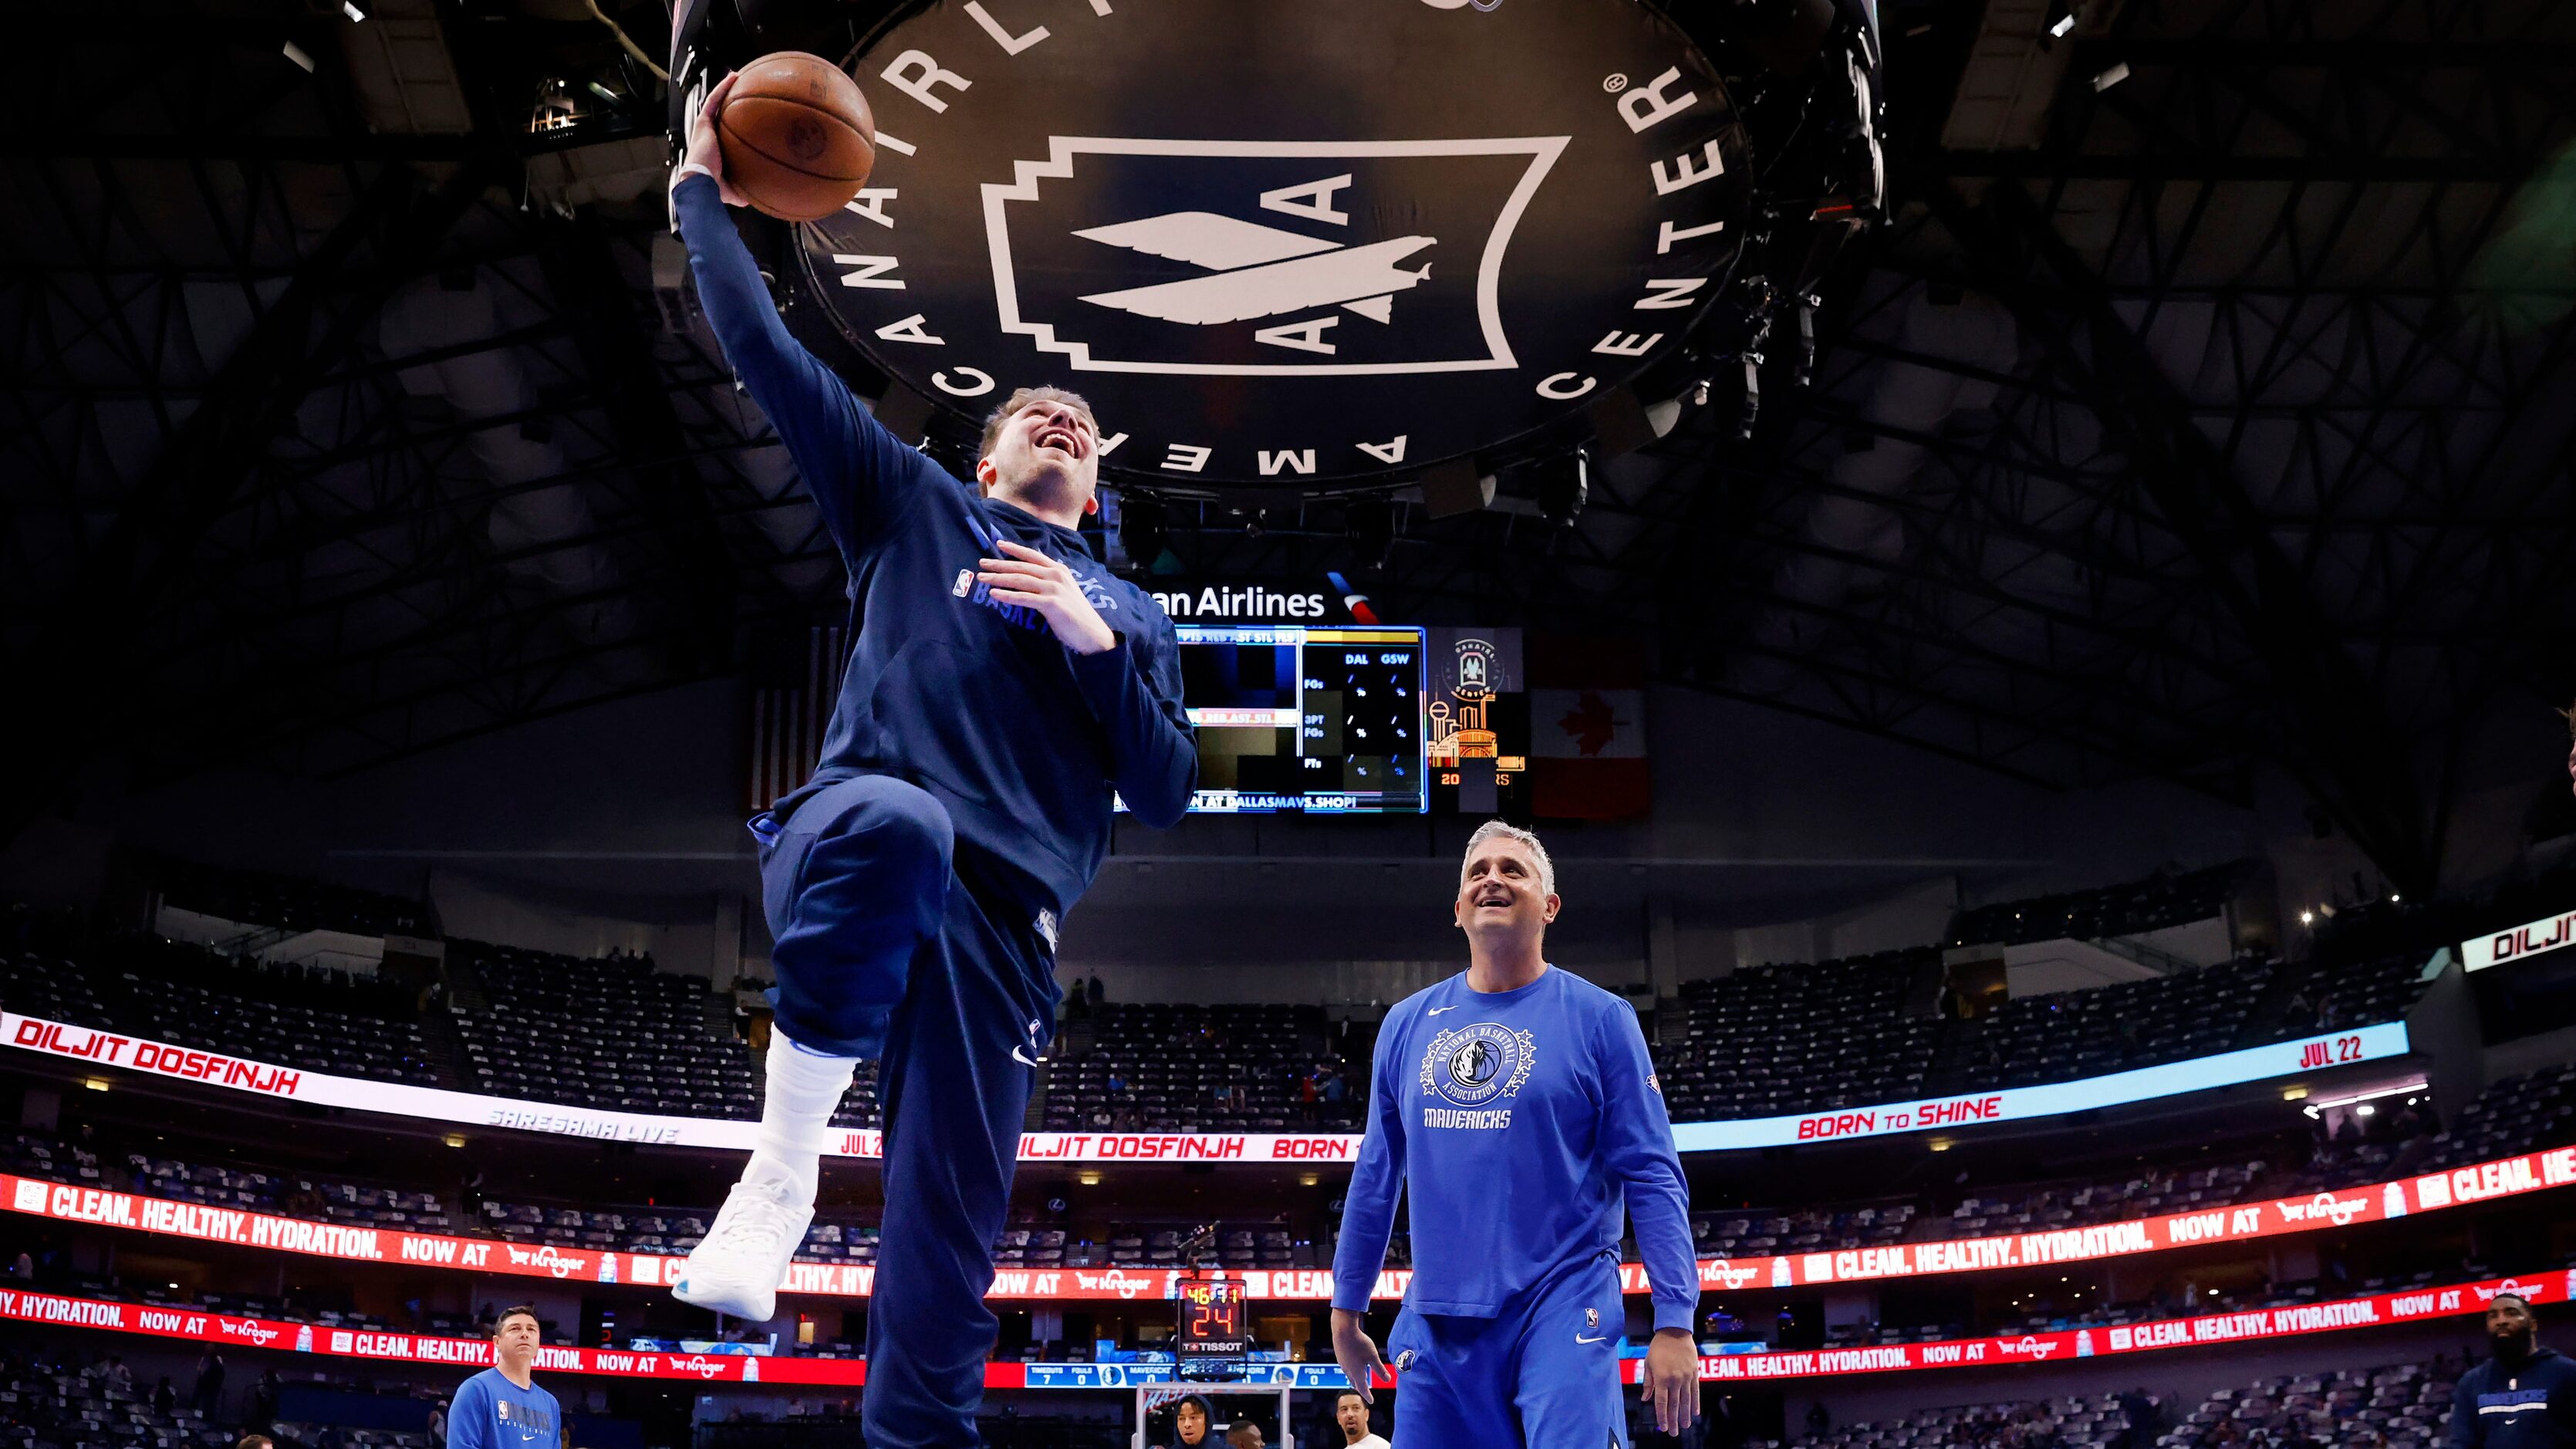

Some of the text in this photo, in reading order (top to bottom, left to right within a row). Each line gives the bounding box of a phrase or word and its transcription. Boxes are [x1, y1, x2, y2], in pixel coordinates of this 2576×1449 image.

[1195, 586, 1325, 616] Airlines
[1345, 654, 1410, 665] DAL GSW
[1304, 679, 1324, 689] FGs
[1305, 715, 1325, 724] 3PT
[1304, 728, 1324, 738] FGs
[1304, 758, 1322, 768] FTs
[1441, 774, 1460, 785] 20
[1207, 796, 1224, 807] AT
[1226, 795, 1357, 808] DALLASMAVS.SHOP!
[2493, 914, 2576, 962] DILJI
[1437, 1028, 1476, 1062] NATIONAL
[1479, 1028, 1516, 1064] BASKETBALL
[2301, 1035, 2362, 1069] JUL 22
[14, 1019, 302, 1096] DILJIT DOSFINJH
[1441, 1081, 1498, 1101] ASSOCIATION
[1423, 1108, 1512, 1130] MAVERICKS
[1798, 1096, 2002, 1140] BORN TO SHINE
[626, 1126, 680, 1144] LIVE
[841, 1134, 883, 1157] JUL 2
[1018, 1137, 1349, 1158] ILJIT DOSFINJH BORN
[1836, 1247, 1913, 1280] CLEAN.
[1916, 1237, 2020, 1273] HEALTHY.
[2021, 1221, 2153, 1264] HYDRATION.
[2169, 1210, 2226, 1243] NOW
[2232, 1207, 2261, 1235] AT
[2306, 1192, 2368, 1226] Kroger
[2453, 1157, 2542, 1202] CLEAN.
[52, 1187, 136, 1227] CLEAN.
[141, 1198, 247, 1243] HEALTHY.
[251, 1215, 383, 1259] HYDRATION.
[401, 1237, 457, 1265] NOW
[462, 1243, 491, 1267] AT
[531, 1245, 586, 1278] Kroger
[1034, 1273, 1062, 1295] AT
[1099, 1268, 1152, 1299] Kroger
[1704, 1259, 1758, 1289] Kroger
[1193, 1306, 1232, 1336] 24
[21, 1295, 125, 1328] HYDRATION.
[139, 1311, 182, 1332] NOW
[184, 1316, 208, 1335] AT
[237, 1319, 279, 1346] Kroger
[356, 1333, 413, 1359] CLEAN.
[417, 1338, 490, 1364] HEALTHY.
[596, 1353, 633, 1373] NOW
[636, 1356, 658, 1373] AT
[687, 1356, 726, 1379] Kroger
[1747, 1355, 1817, 1376] HEALTHY.
[1819, 1346, 1911, 1372] HYDRATION.
[1923, 1346, 1961, 1364] NOW
[1966, 1343, 1987, 1360] AT
[2016, 1336, 2058, 1359] Kroger
[2133, 1321, 2193, 1348] CLEAN.
[2193, 1310, 2274, 1342] HEALTHY.
[2274, 1300, 2380, 1333] HYDRATION.
[2391, 1294, 2435, 1317] NOW
[2438, 1289, 2462, 1311] AT
[1199, 1342, 1243, 1352] TISSOT
[1043, 1374, 1051, 1385] 7
[1077, 1374, 1086, 1385] 0
[1310, 1375, 1318, 1386] 0
